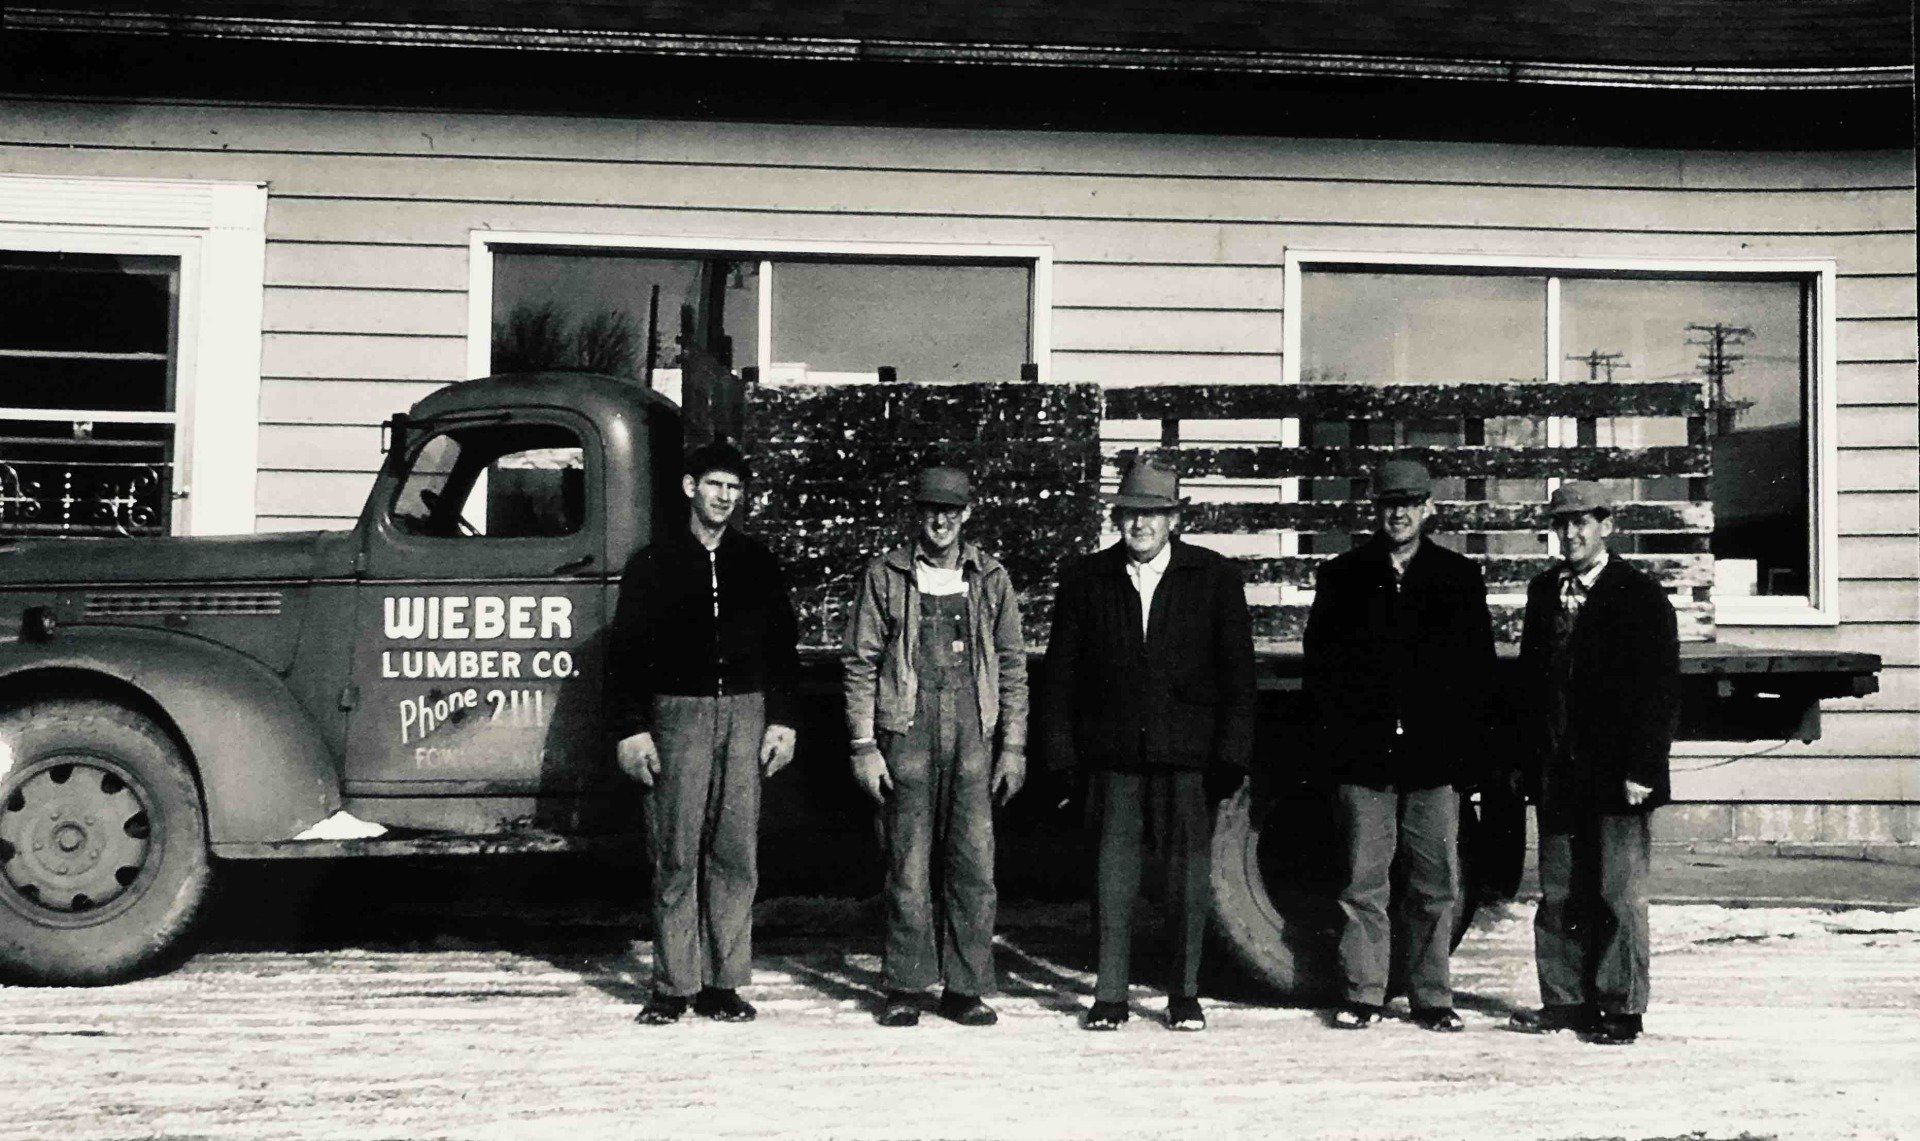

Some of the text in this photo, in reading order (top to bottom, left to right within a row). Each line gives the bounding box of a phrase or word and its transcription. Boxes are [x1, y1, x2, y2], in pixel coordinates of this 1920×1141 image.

[384, 596, 573, 640] WIEBER
[382, 651, 580, 679] LUMBER CO.
[400, 688, 545, 744] Phone 2111
